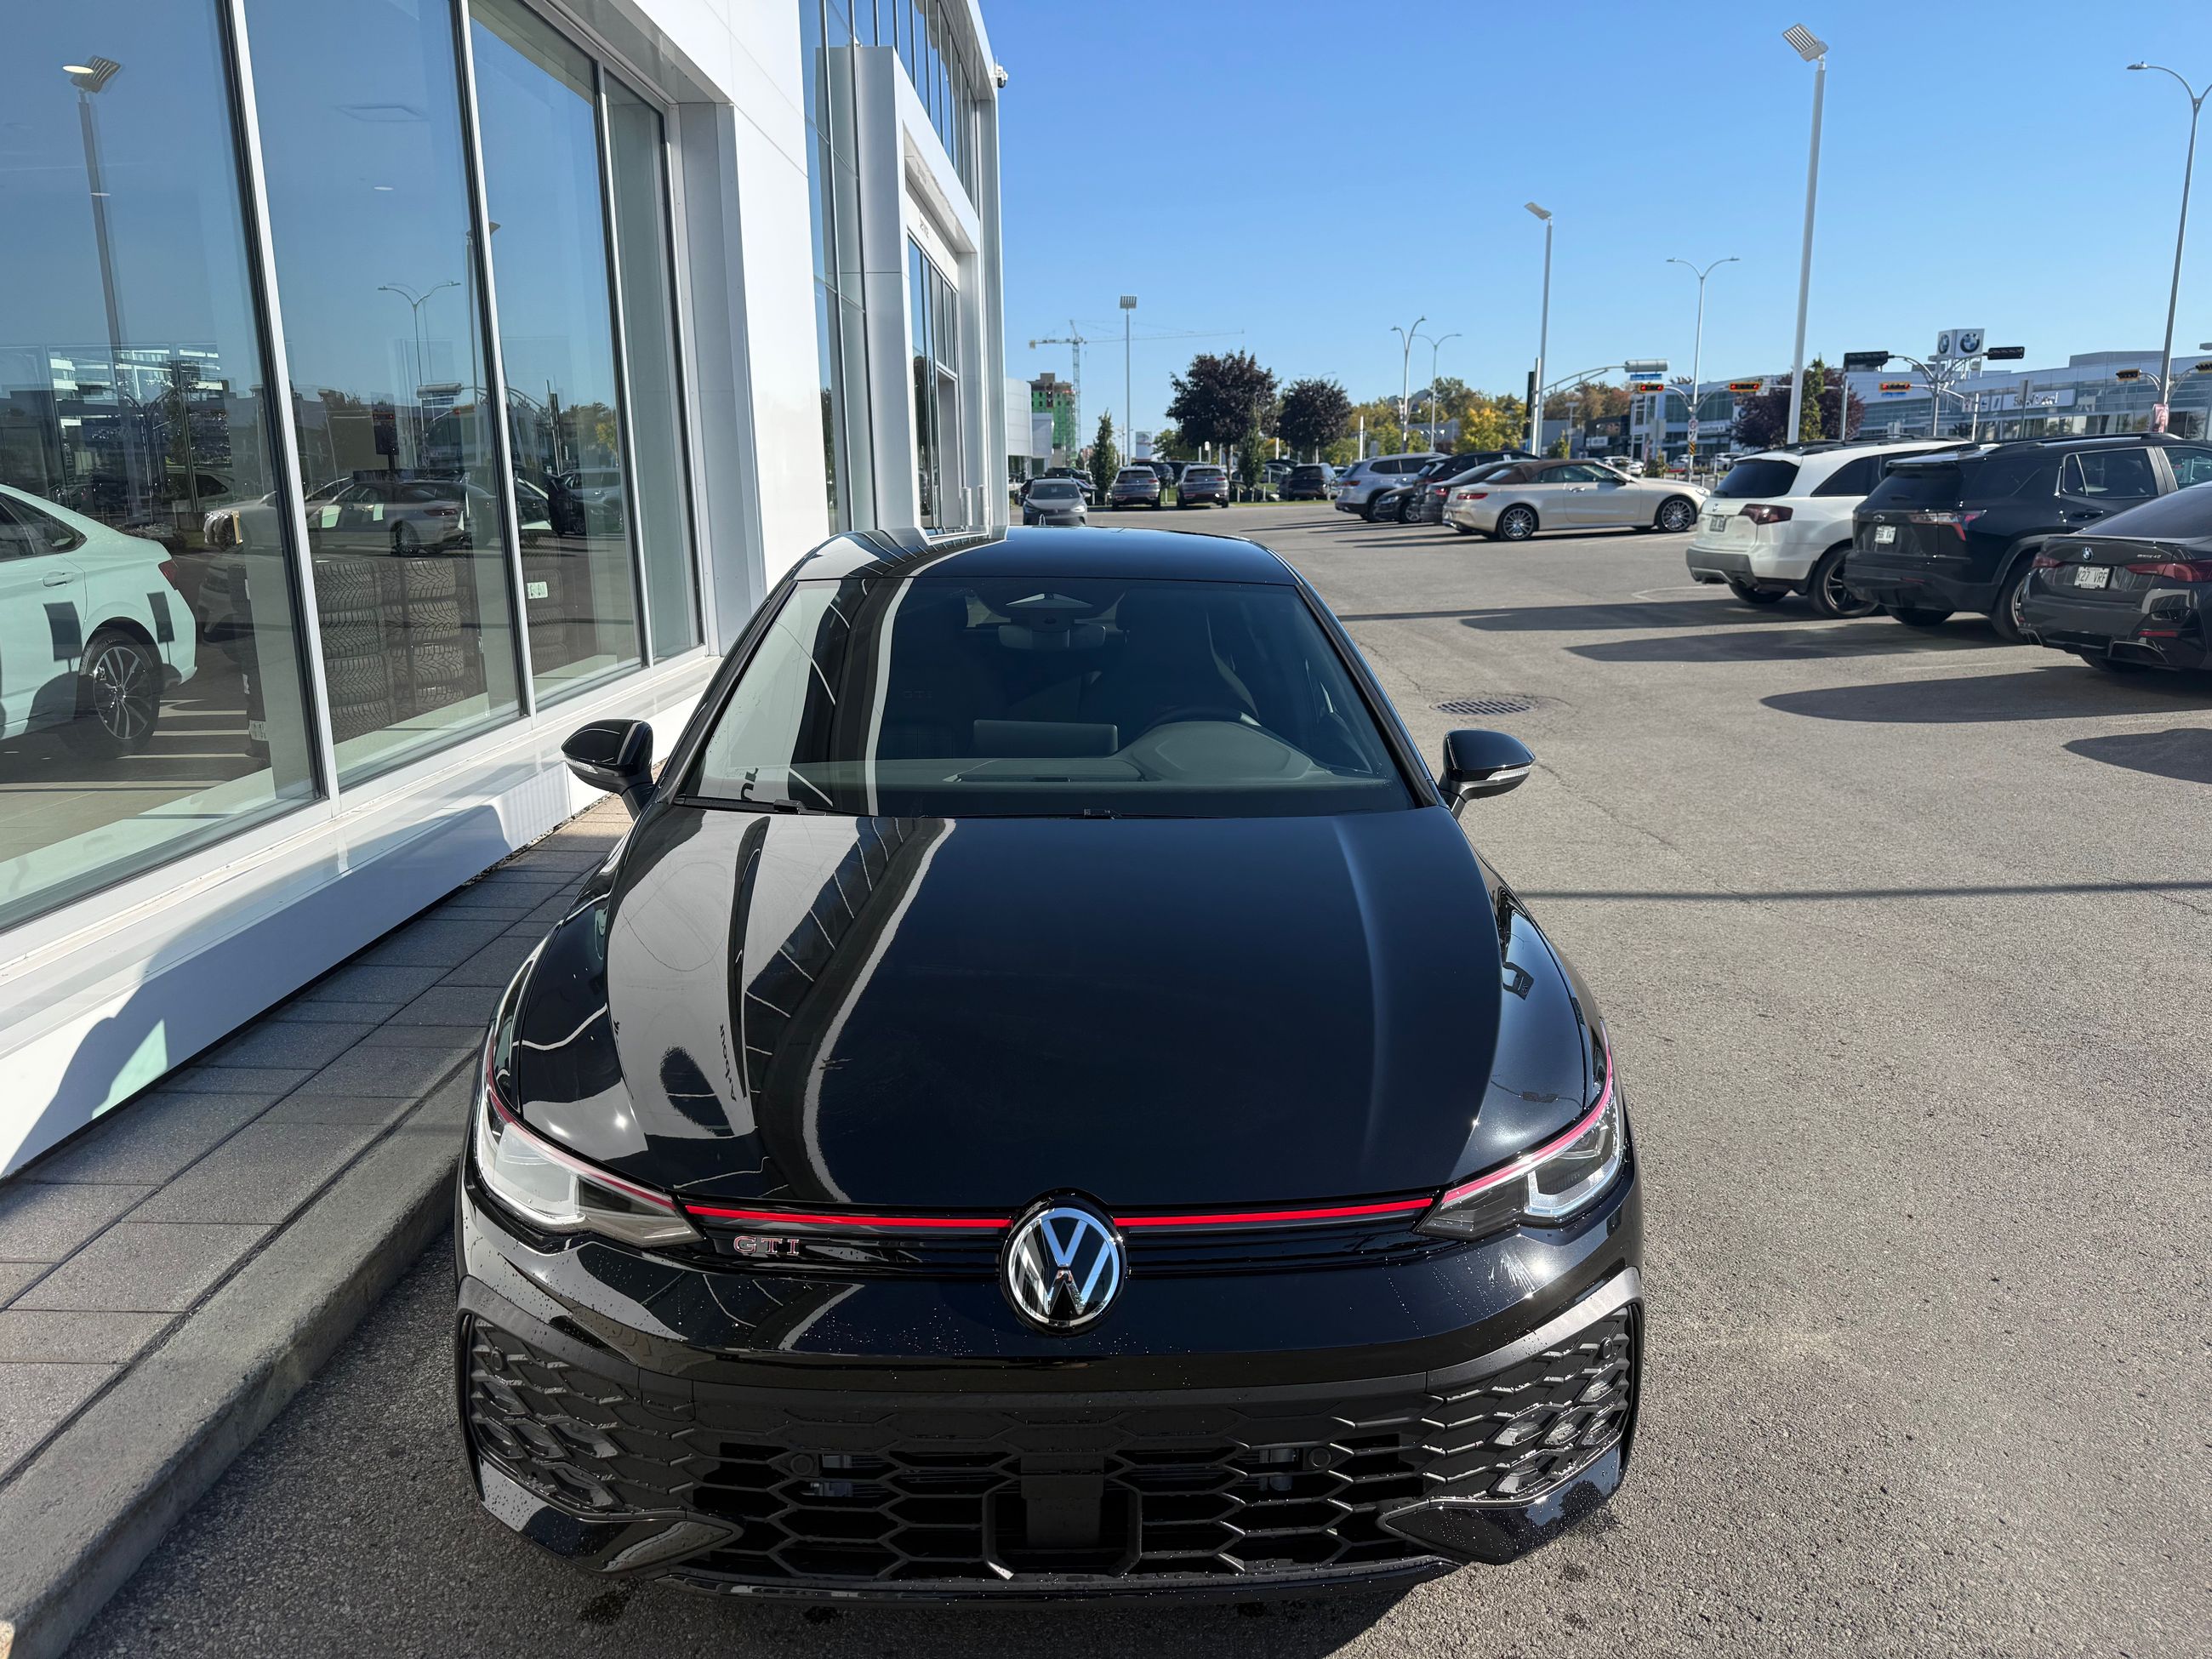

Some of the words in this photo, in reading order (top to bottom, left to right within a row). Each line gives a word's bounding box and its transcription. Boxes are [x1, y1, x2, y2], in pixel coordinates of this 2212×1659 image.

[2076, 570, 2090, 582] K27
[2094, 571, 2108, 583] VRF
[733, 1235, 800, 1256] GTI
